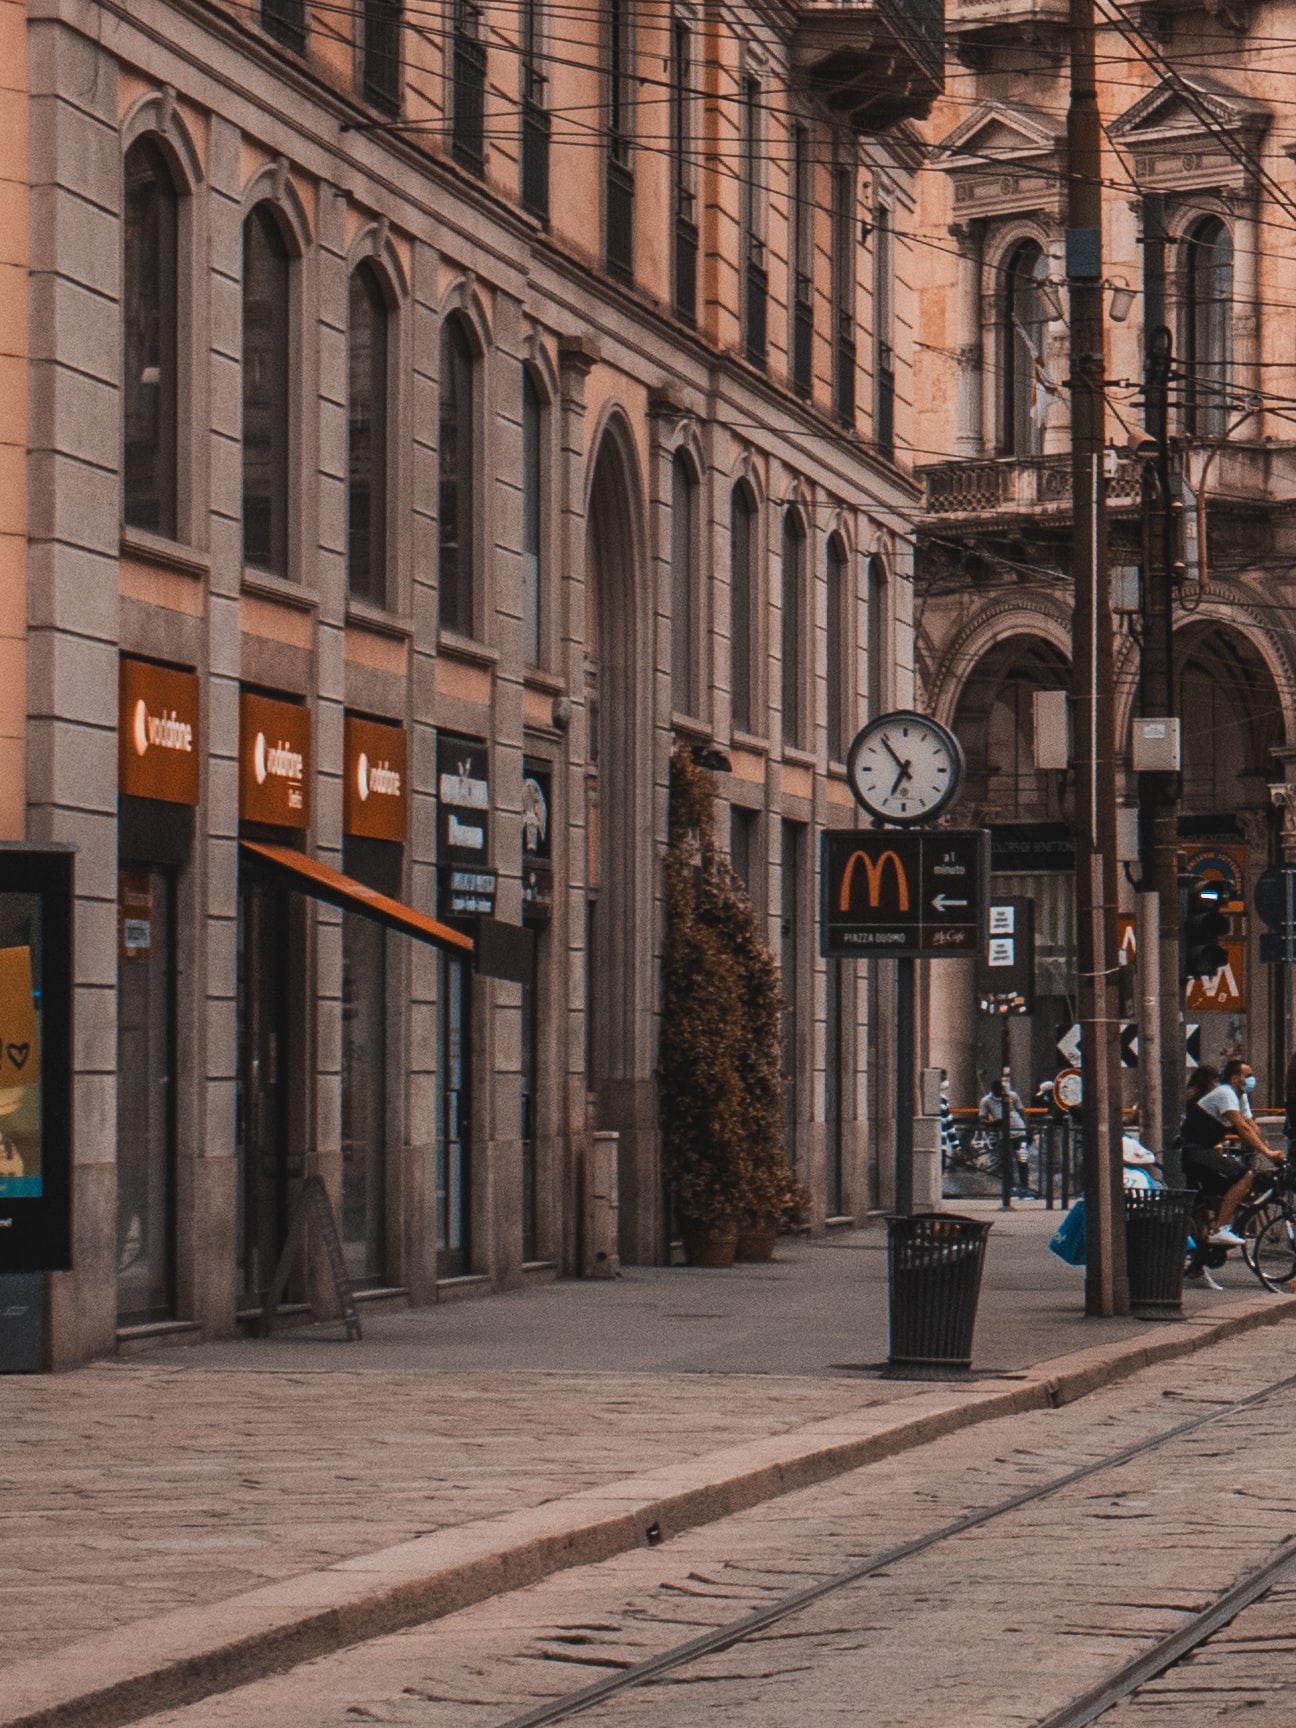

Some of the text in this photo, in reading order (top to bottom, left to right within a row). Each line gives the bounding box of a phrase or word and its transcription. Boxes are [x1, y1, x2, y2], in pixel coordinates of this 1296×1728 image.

[147, 709, 193, 753] vodafone
[266, 739, 303, 780] vodafone
[368, 760, 401, 797] vodafone
[843, 932, 906, 944] PIAZZA DUOMO
